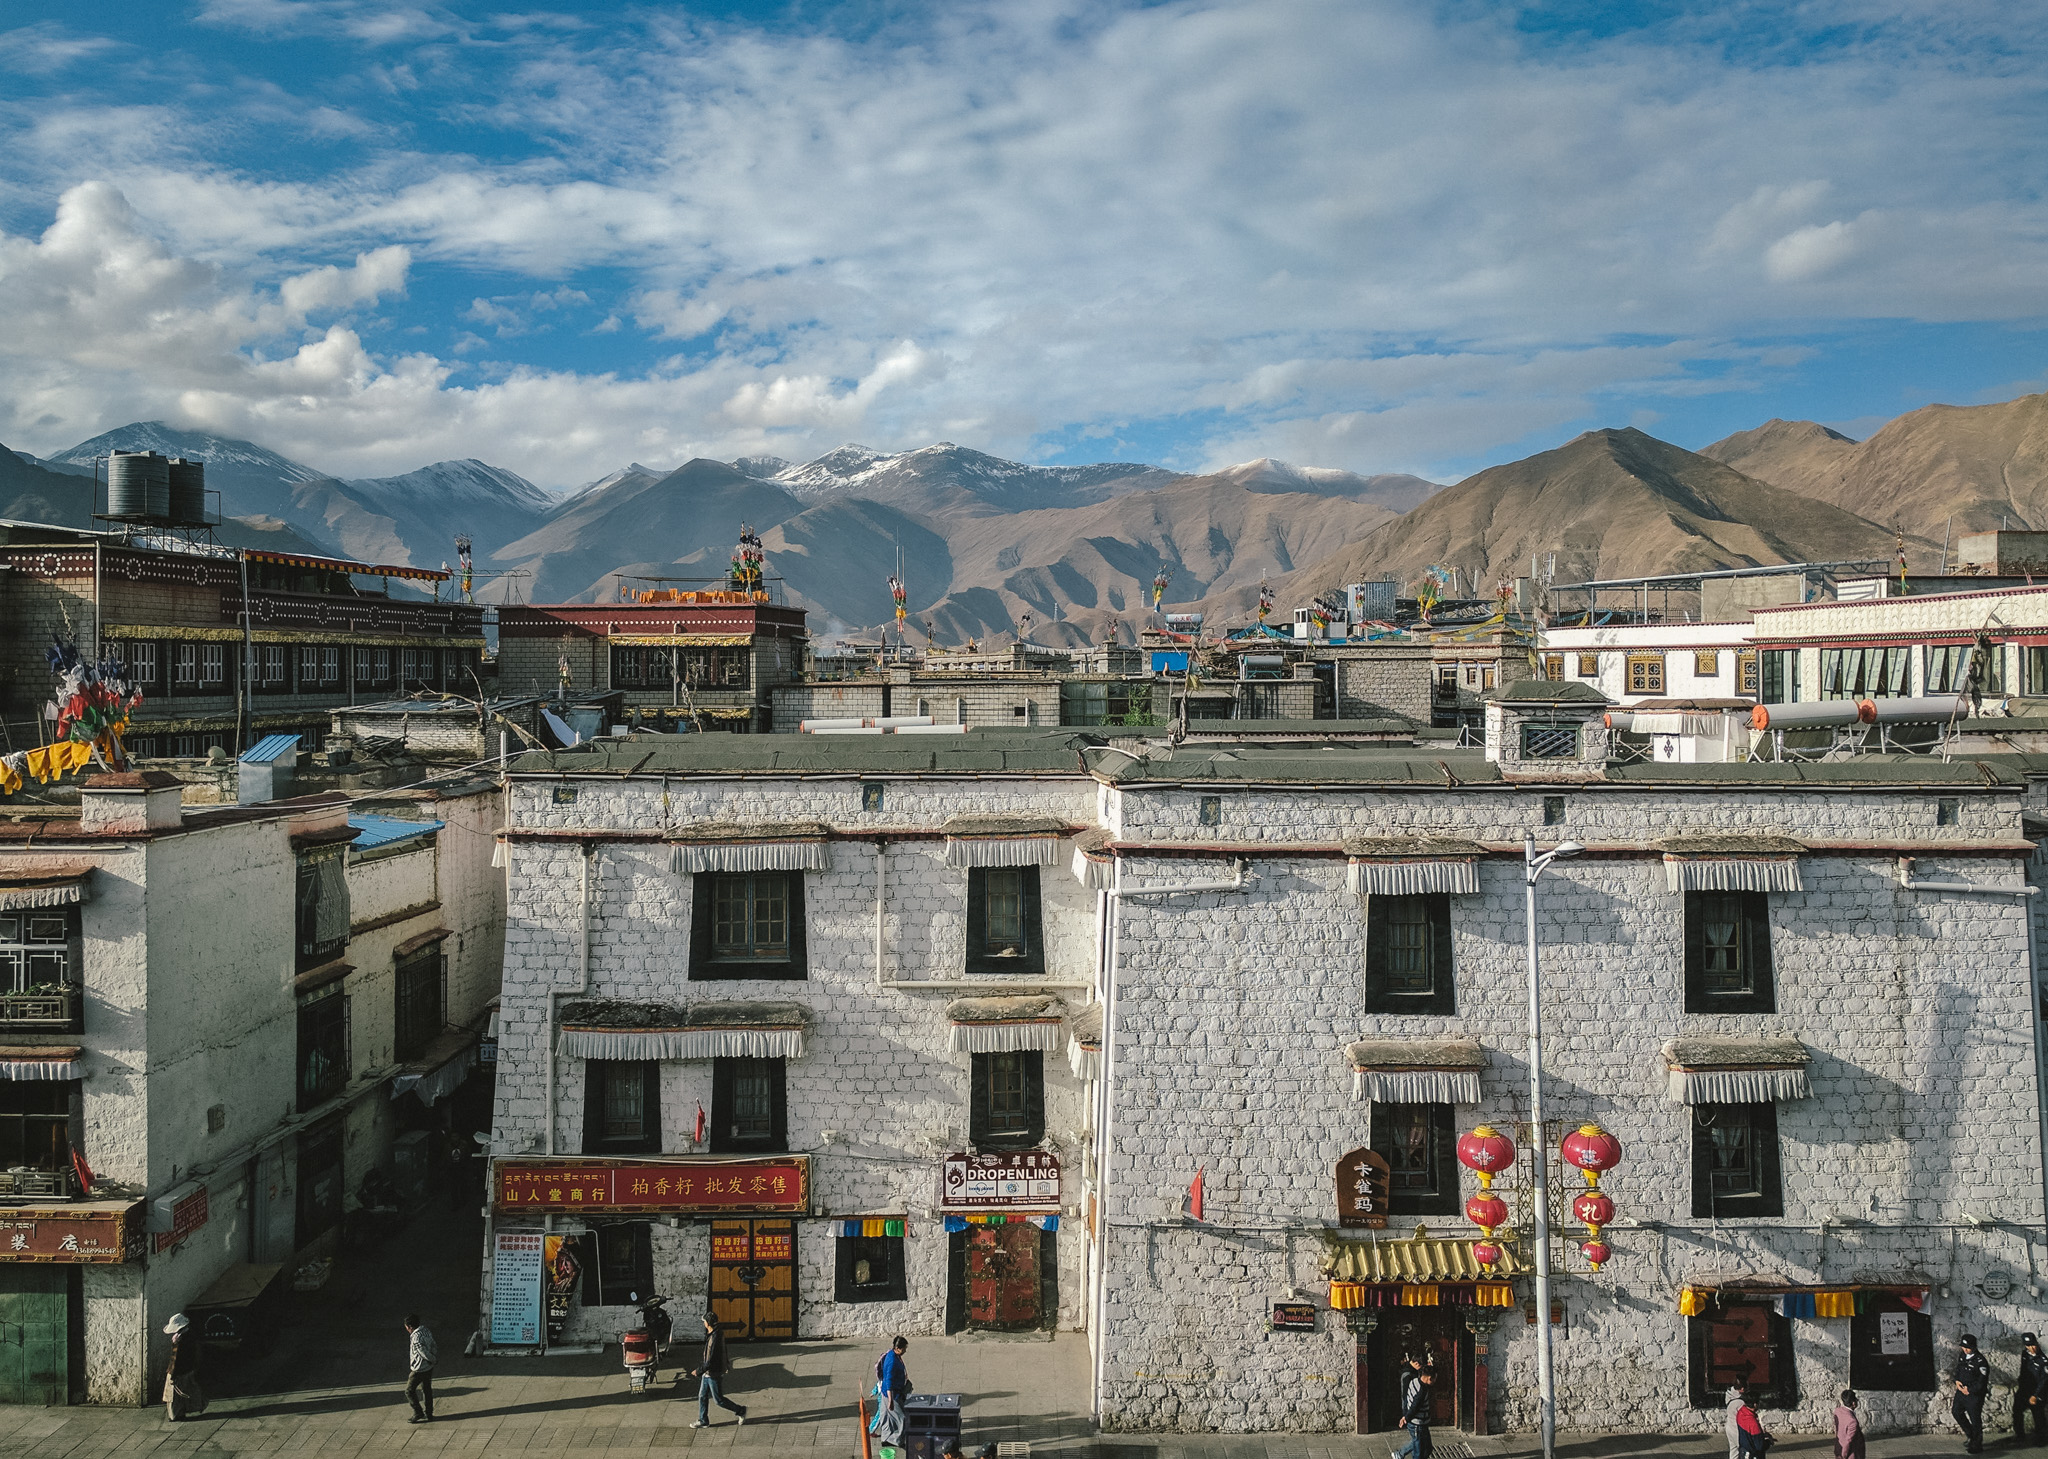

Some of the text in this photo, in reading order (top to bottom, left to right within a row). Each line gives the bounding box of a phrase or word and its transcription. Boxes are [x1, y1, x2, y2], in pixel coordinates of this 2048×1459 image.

[967, 1168, 1058, 1180] DROPENLING
[631, 1176, 787, 1196] 柏香籽 批发零售
[1353, 1161, 1373, 1212] 卡雀玛
[506, 1188, 605, 1201] 山人堂商行
